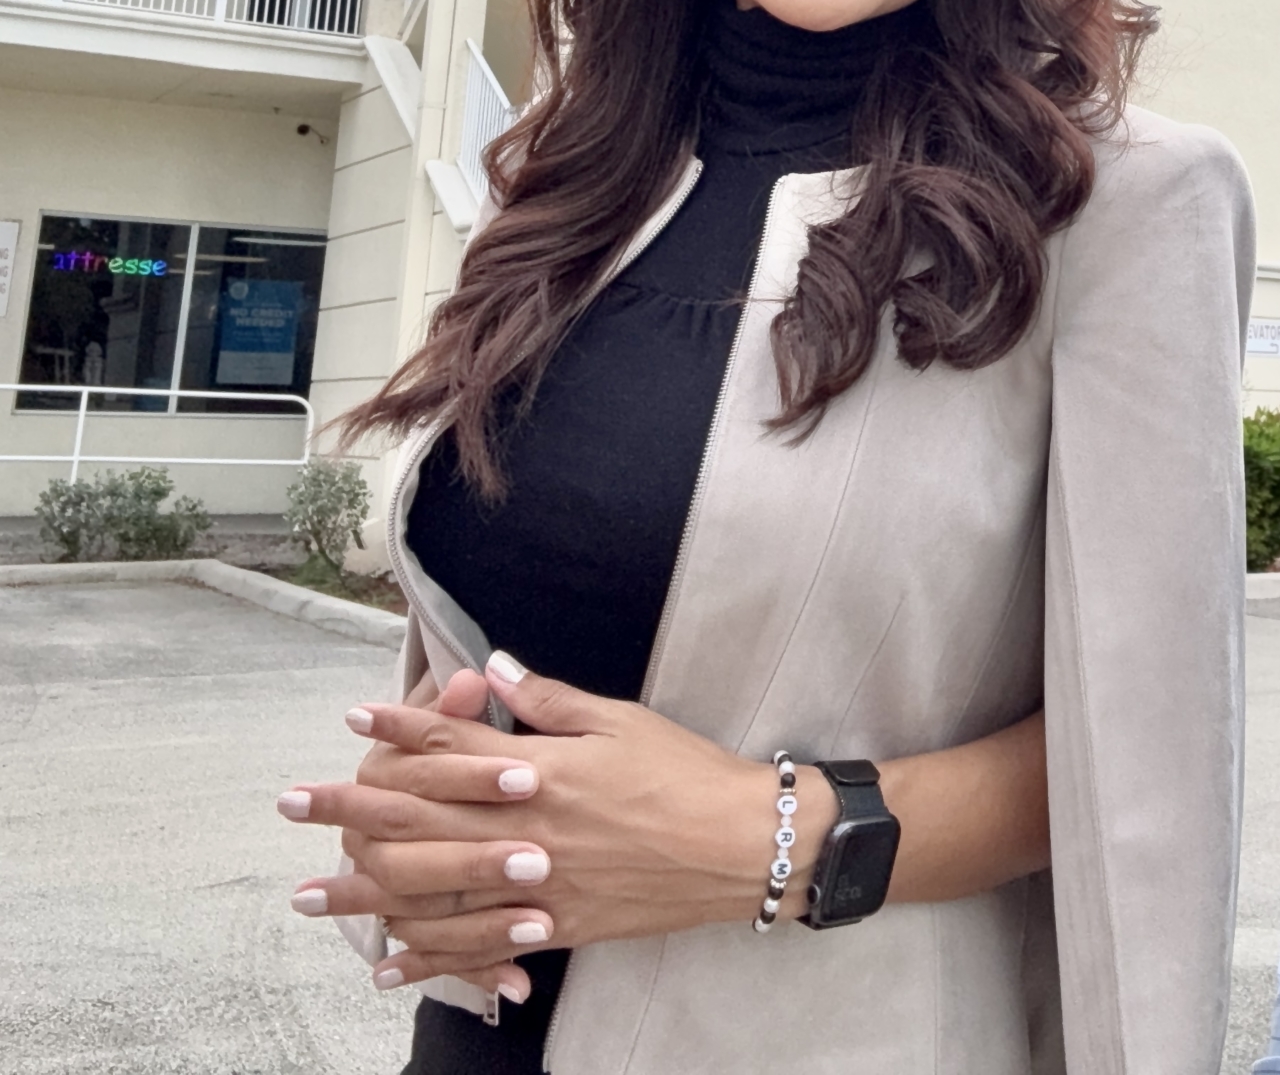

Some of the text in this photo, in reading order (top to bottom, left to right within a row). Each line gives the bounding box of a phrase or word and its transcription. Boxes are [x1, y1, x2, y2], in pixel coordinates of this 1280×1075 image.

[229, 307, 294, 318] NO CREDIT
[235, 317, 286, 327] NEEDED
